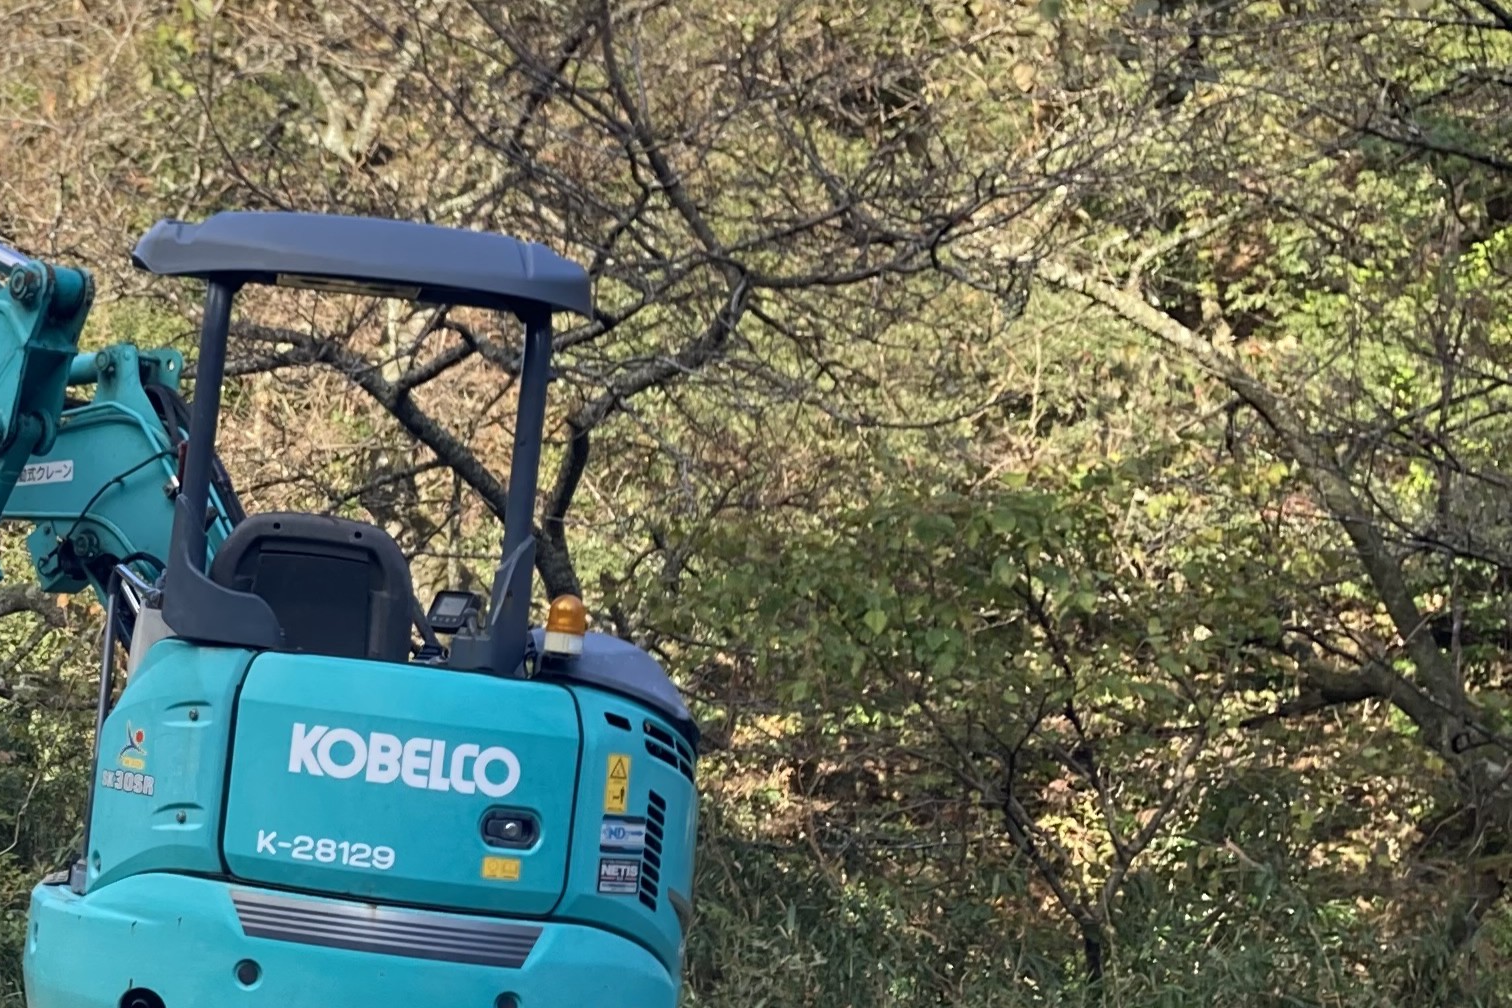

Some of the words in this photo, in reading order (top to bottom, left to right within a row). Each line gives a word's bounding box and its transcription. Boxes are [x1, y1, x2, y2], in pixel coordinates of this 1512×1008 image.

[288, 722, 521, 797] KOBELCO
[256, 829, 395, 870] K-28129
[601, 864, 638, 878] NETIS
